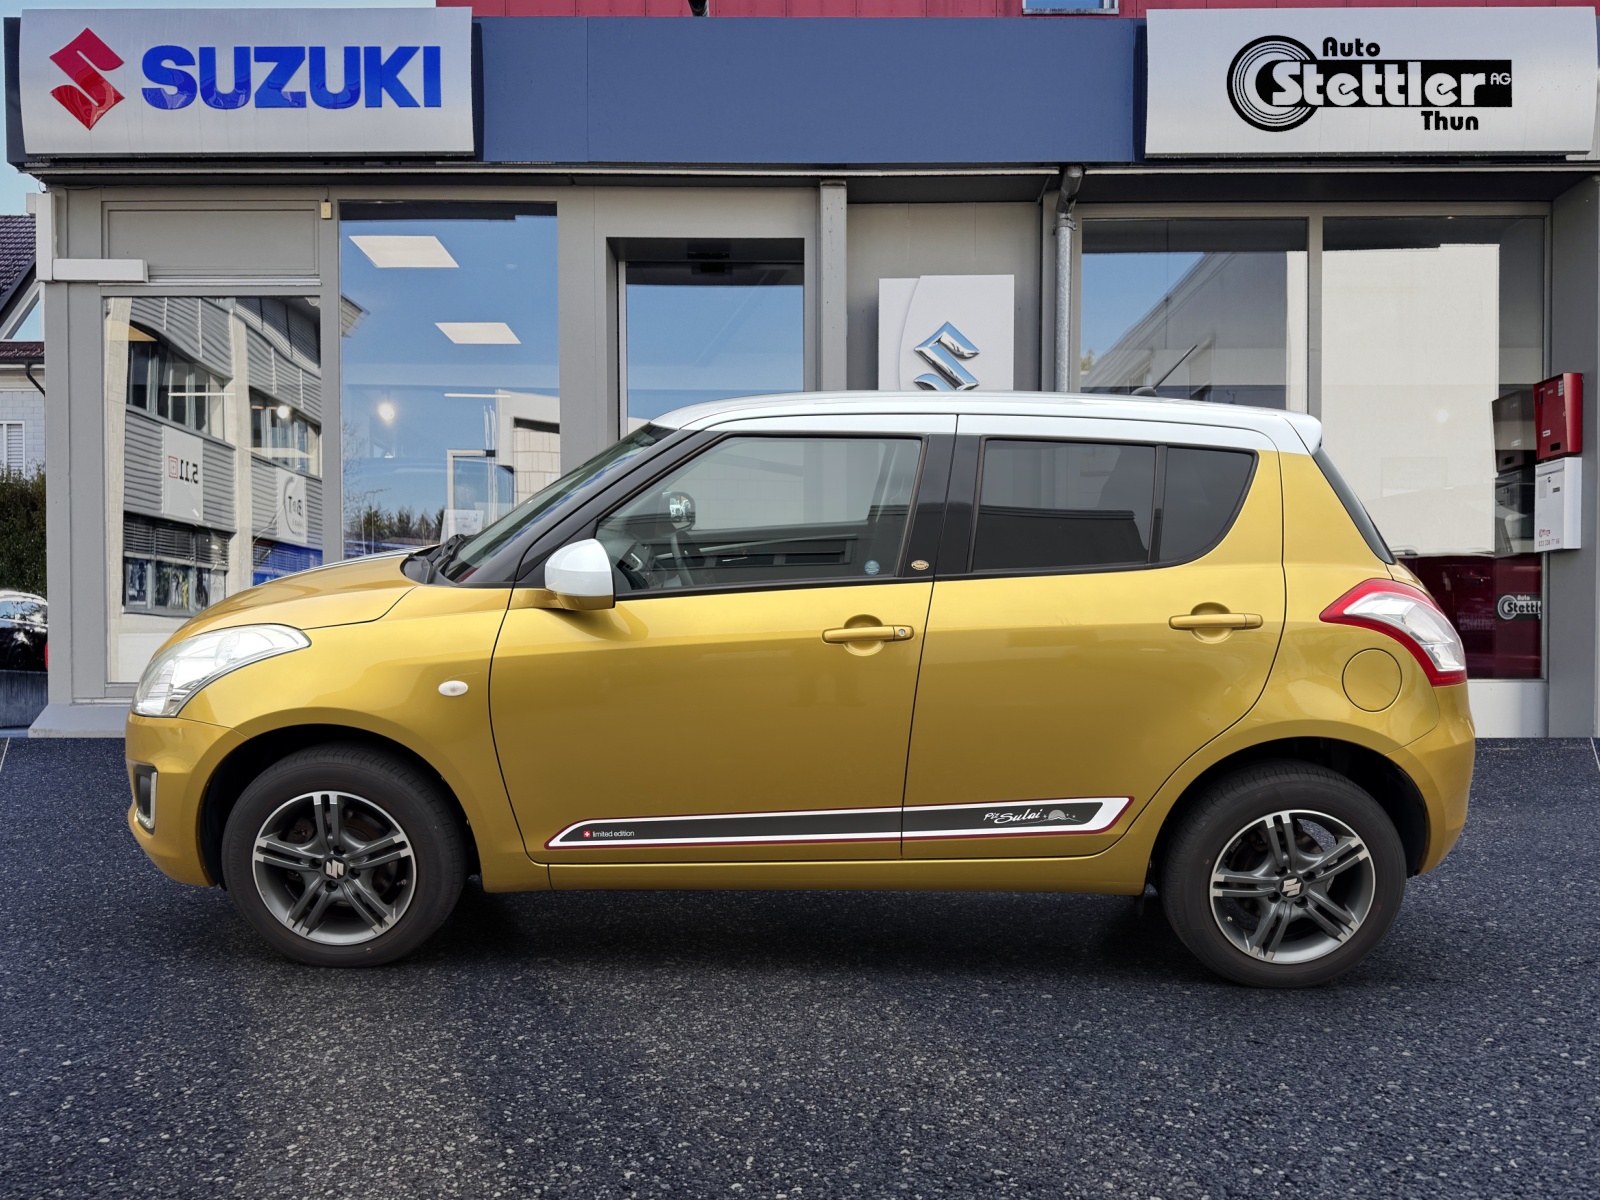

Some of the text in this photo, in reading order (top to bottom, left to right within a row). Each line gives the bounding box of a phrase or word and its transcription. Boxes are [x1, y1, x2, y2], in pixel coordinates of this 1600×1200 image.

[1322, 36, 1381, 57] Auto
[141, 44, 441, 110] SUZUKI
[1272, 61, 1512, 106] Stettler AG
[1420, 111, 1479, 131] Thun
[983, 808, 1043, 823] Piz Sulai
[592, 829, 635, 838] limited edition
